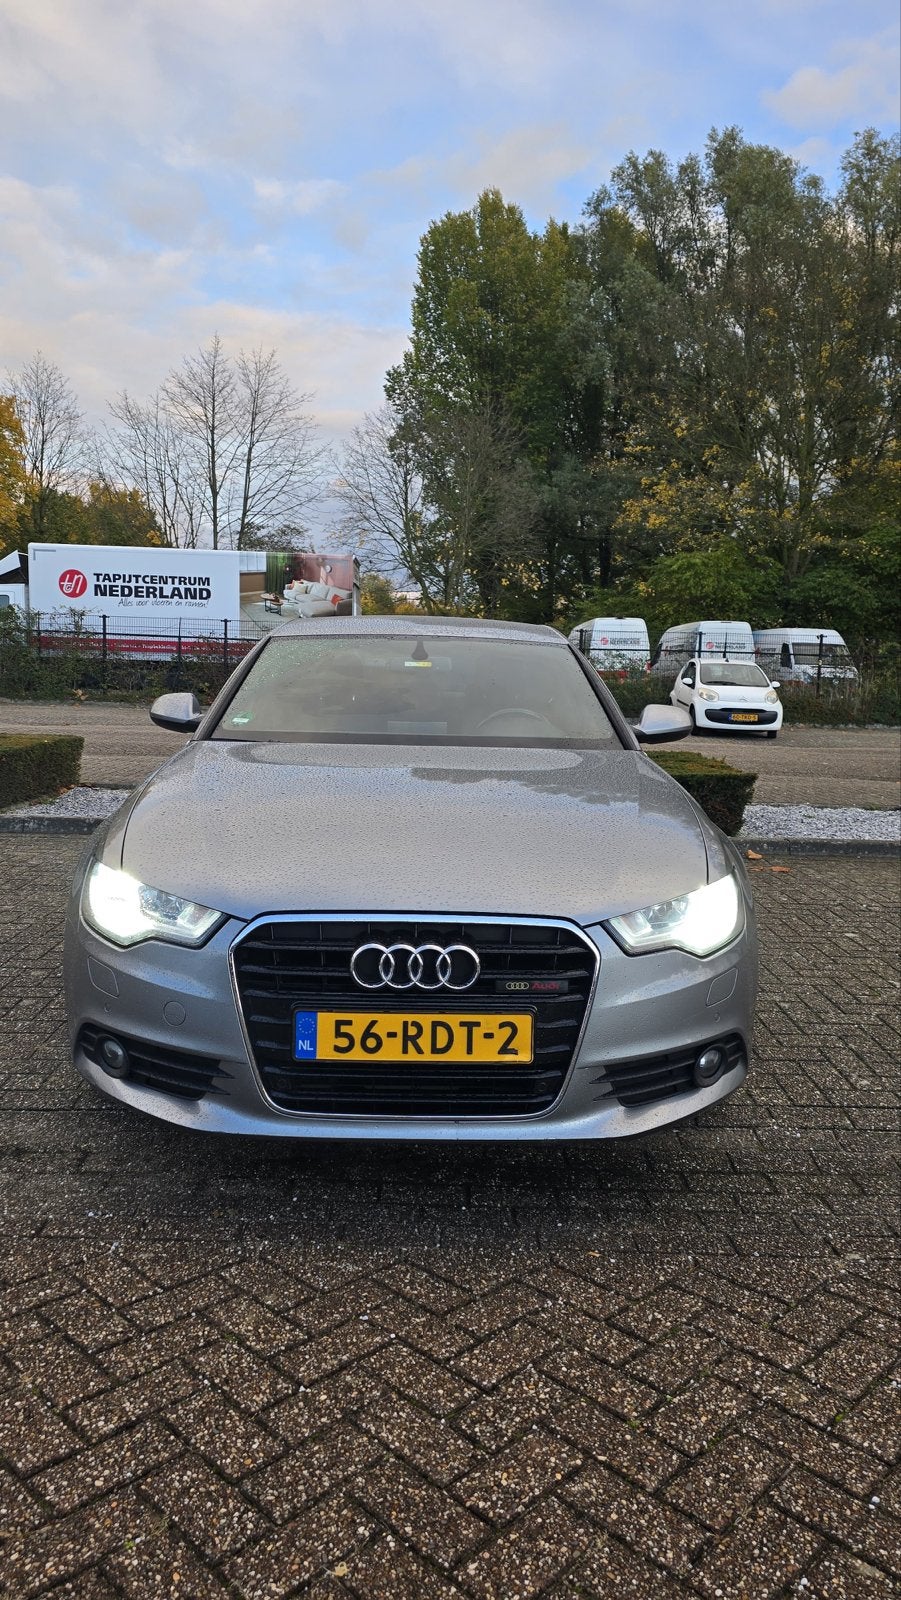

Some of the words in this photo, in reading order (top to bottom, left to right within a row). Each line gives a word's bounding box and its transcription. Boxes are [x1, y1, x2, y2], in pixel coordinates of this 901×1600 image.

[93, 573, 211, 586] TAPIJTCENTRUM
[93, 584, 212, 600] NEDERLAND
[118, 598, 133, 607] Alles
[152, 598, 173, 606] vloeren
[185, 600, 209, 608] ramen!
[333, 1019, 519, 1056] 56-RDT-2
[298, 1040, 314, 1051] NL
